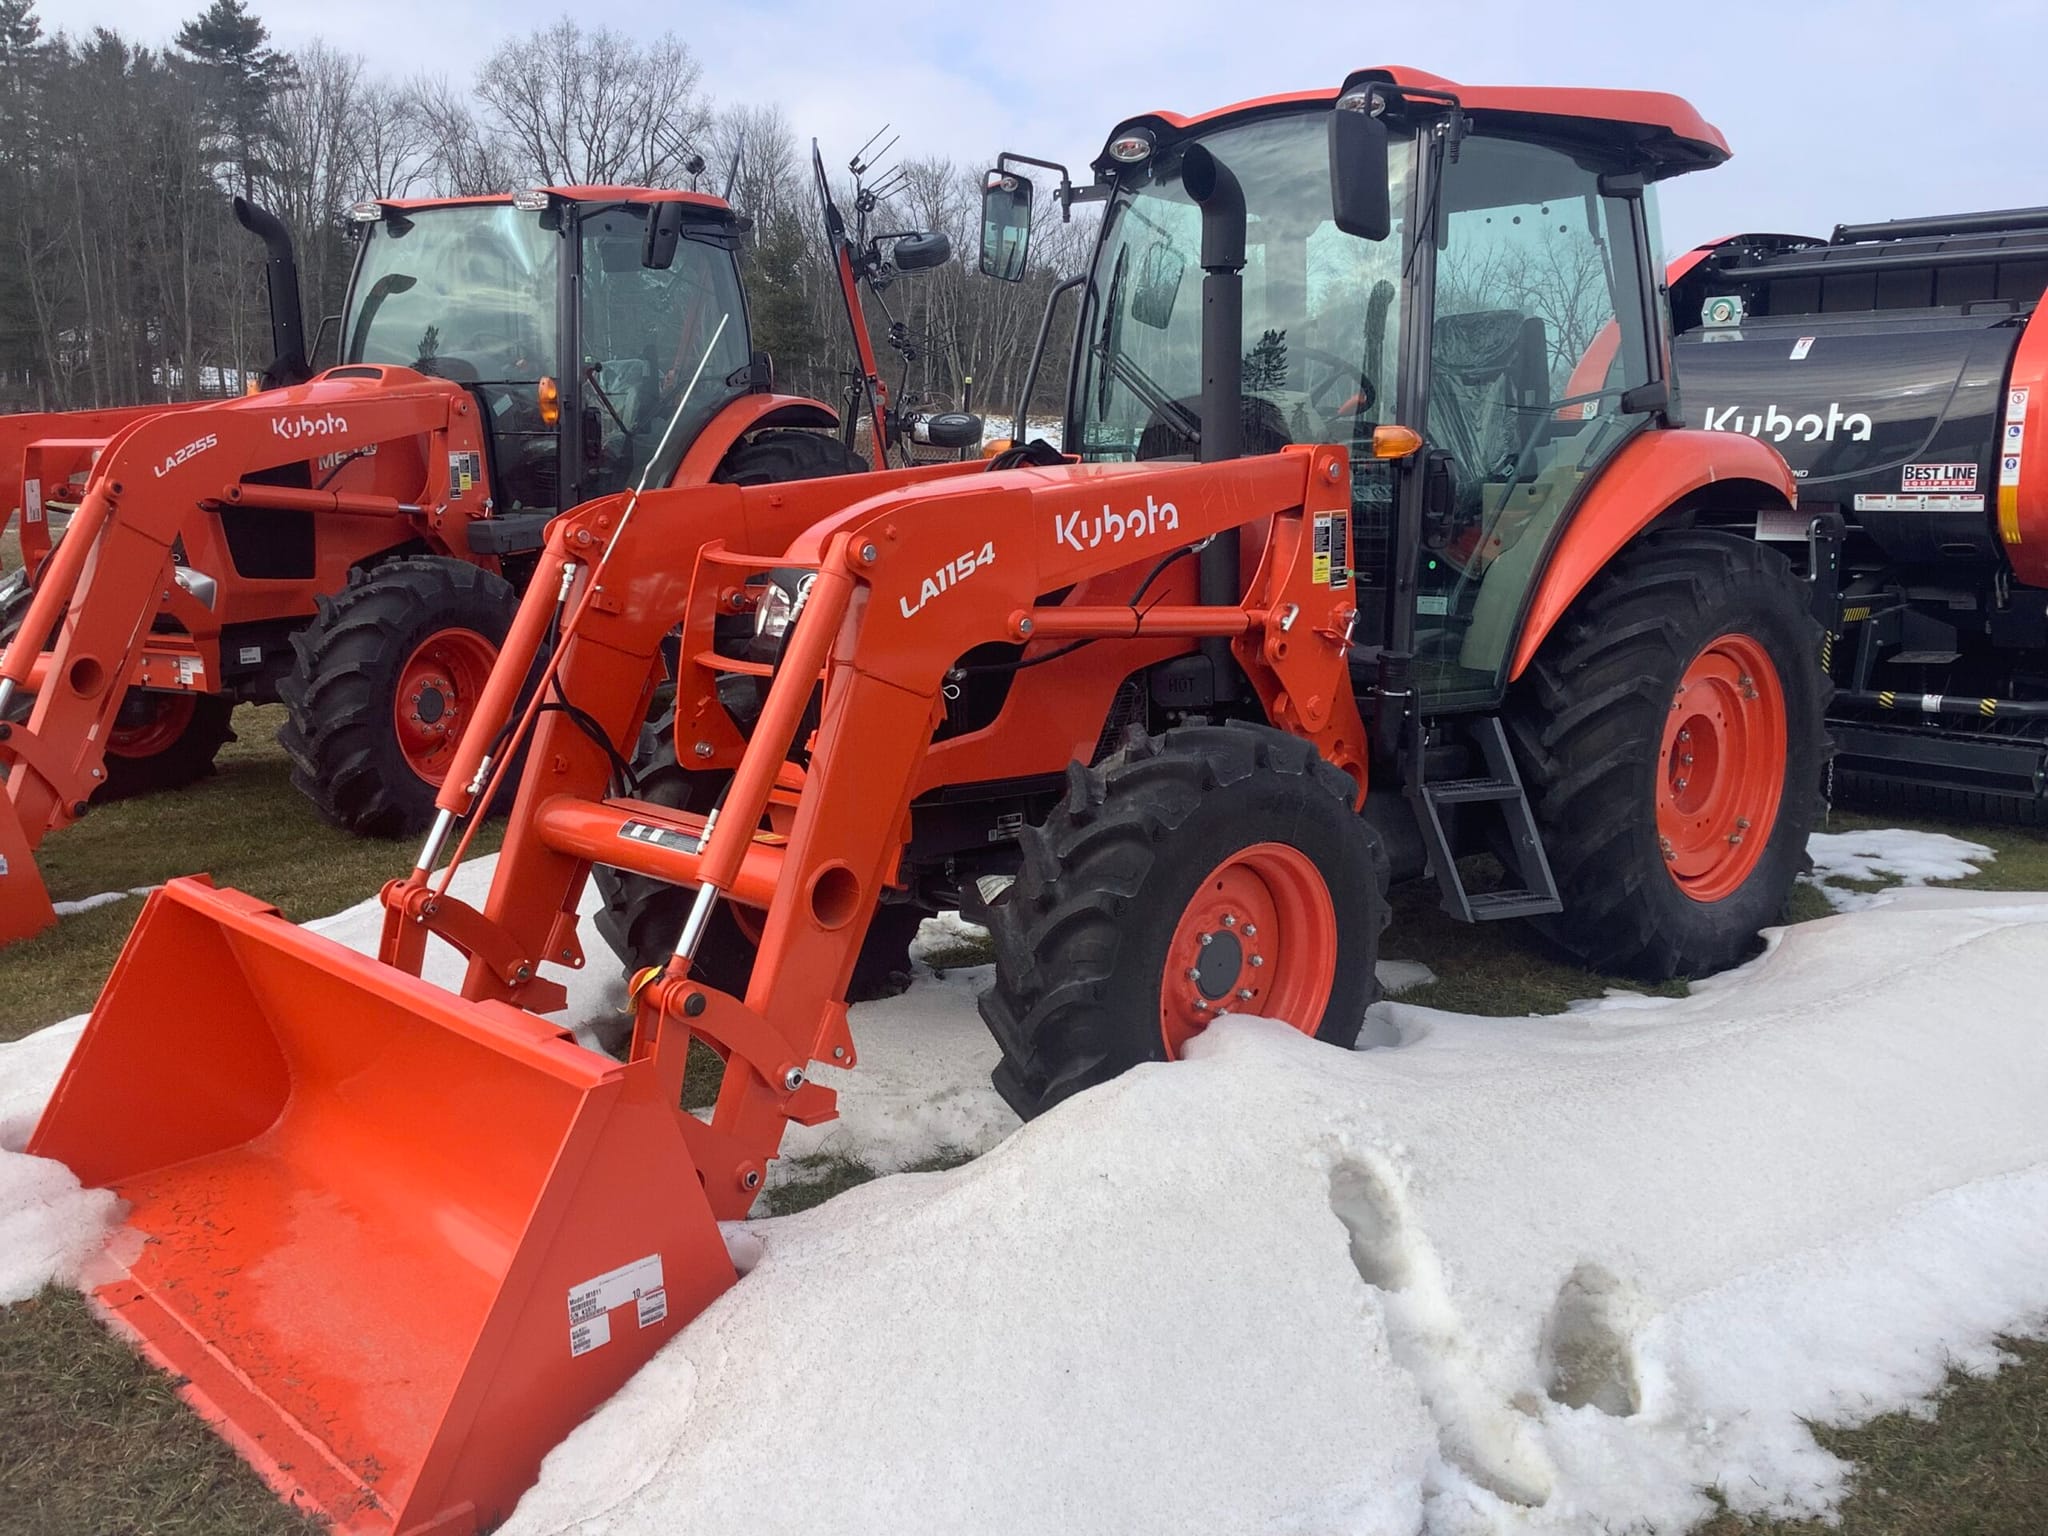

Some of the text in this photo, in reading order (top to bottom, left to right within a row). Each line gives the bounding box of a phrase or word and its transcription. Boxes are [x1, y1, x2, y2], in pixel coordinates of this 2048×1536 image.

[271, 412, 348, 440] Kubota
[1704, 402, 1872, 441] Kubota
[153, 433, 218, 478] LA2255
[1905, 465, 1976, 480] BEST LINE
[1055, 495, 1179, 552] Kubota
[899, 541, 996, 618] LA1154
